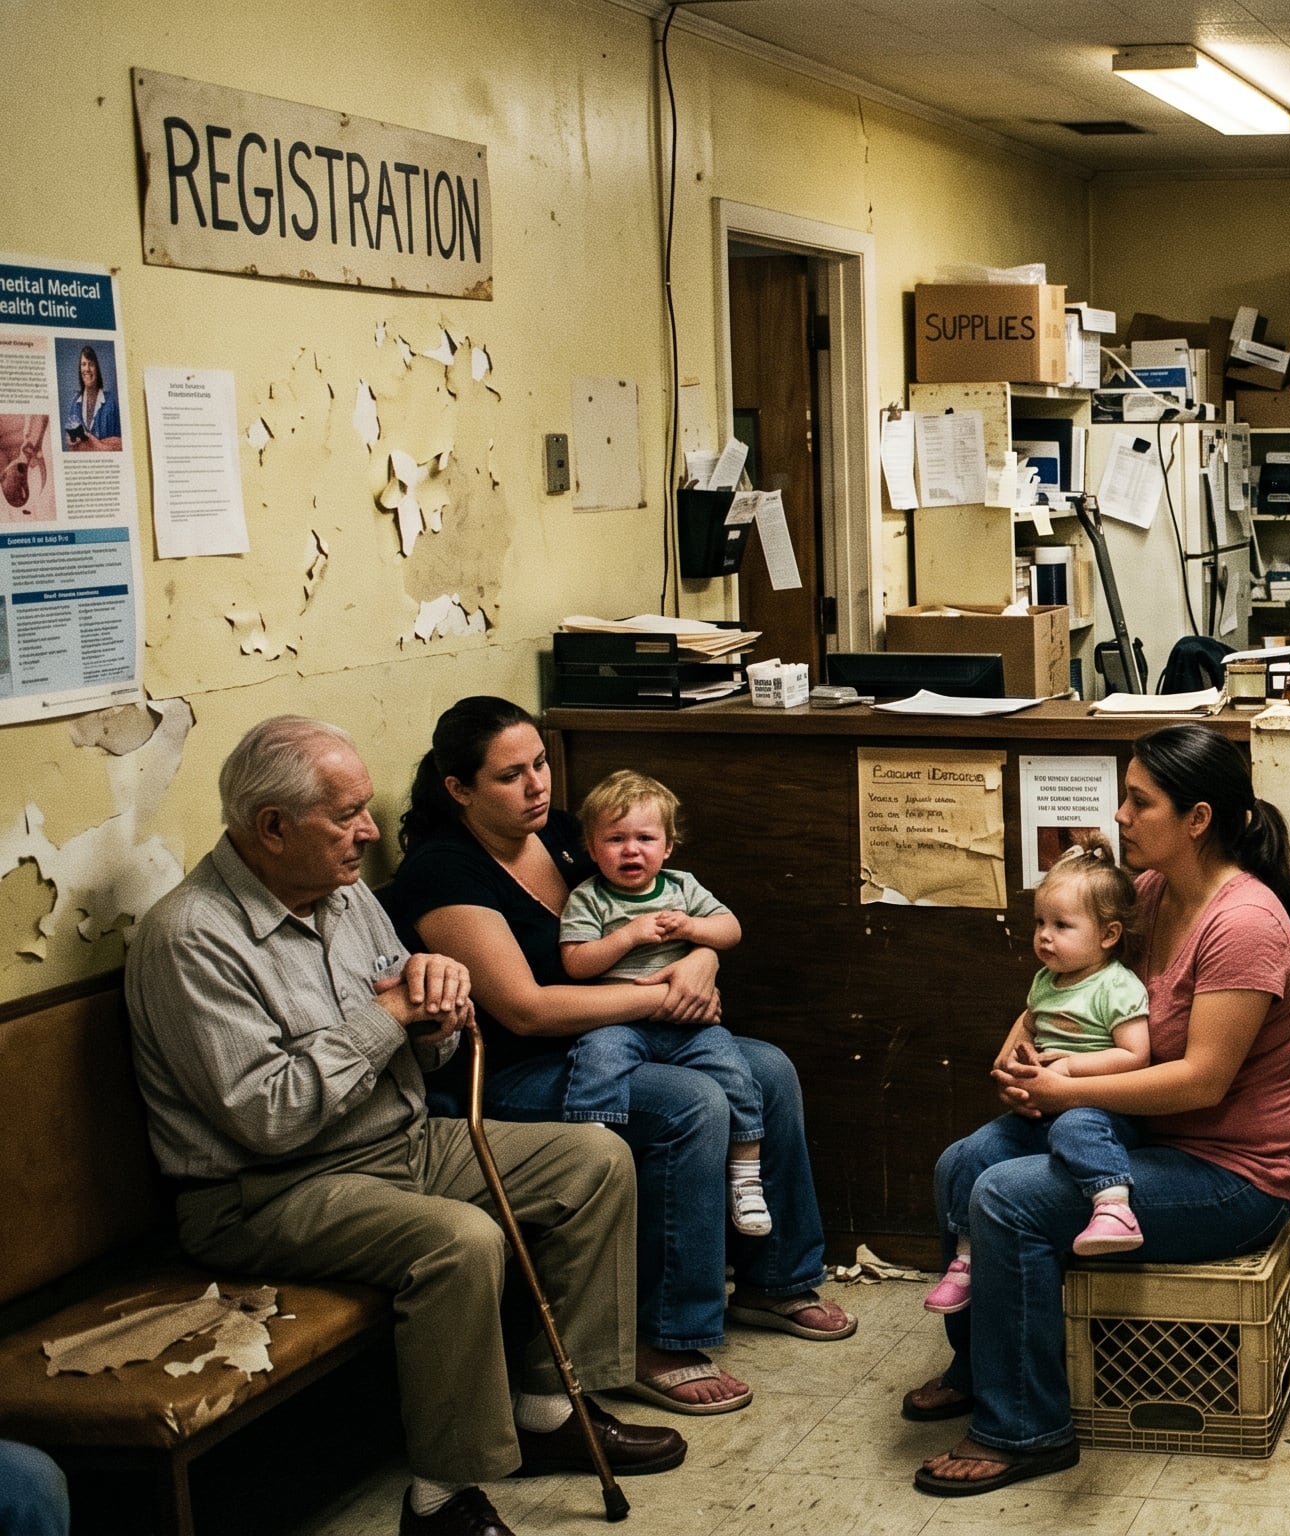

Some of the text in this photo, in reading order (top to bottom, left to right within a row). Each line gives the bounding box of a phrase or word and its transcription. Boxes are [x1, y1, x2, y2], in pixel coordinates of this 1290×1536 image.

[163, 114, 482, 264] REGISTRATION
[48, 279, 101, 299] Medical
[38, 300, 77, 318] Clinic
[925, 313, 1035, 342] SUPPLIES
